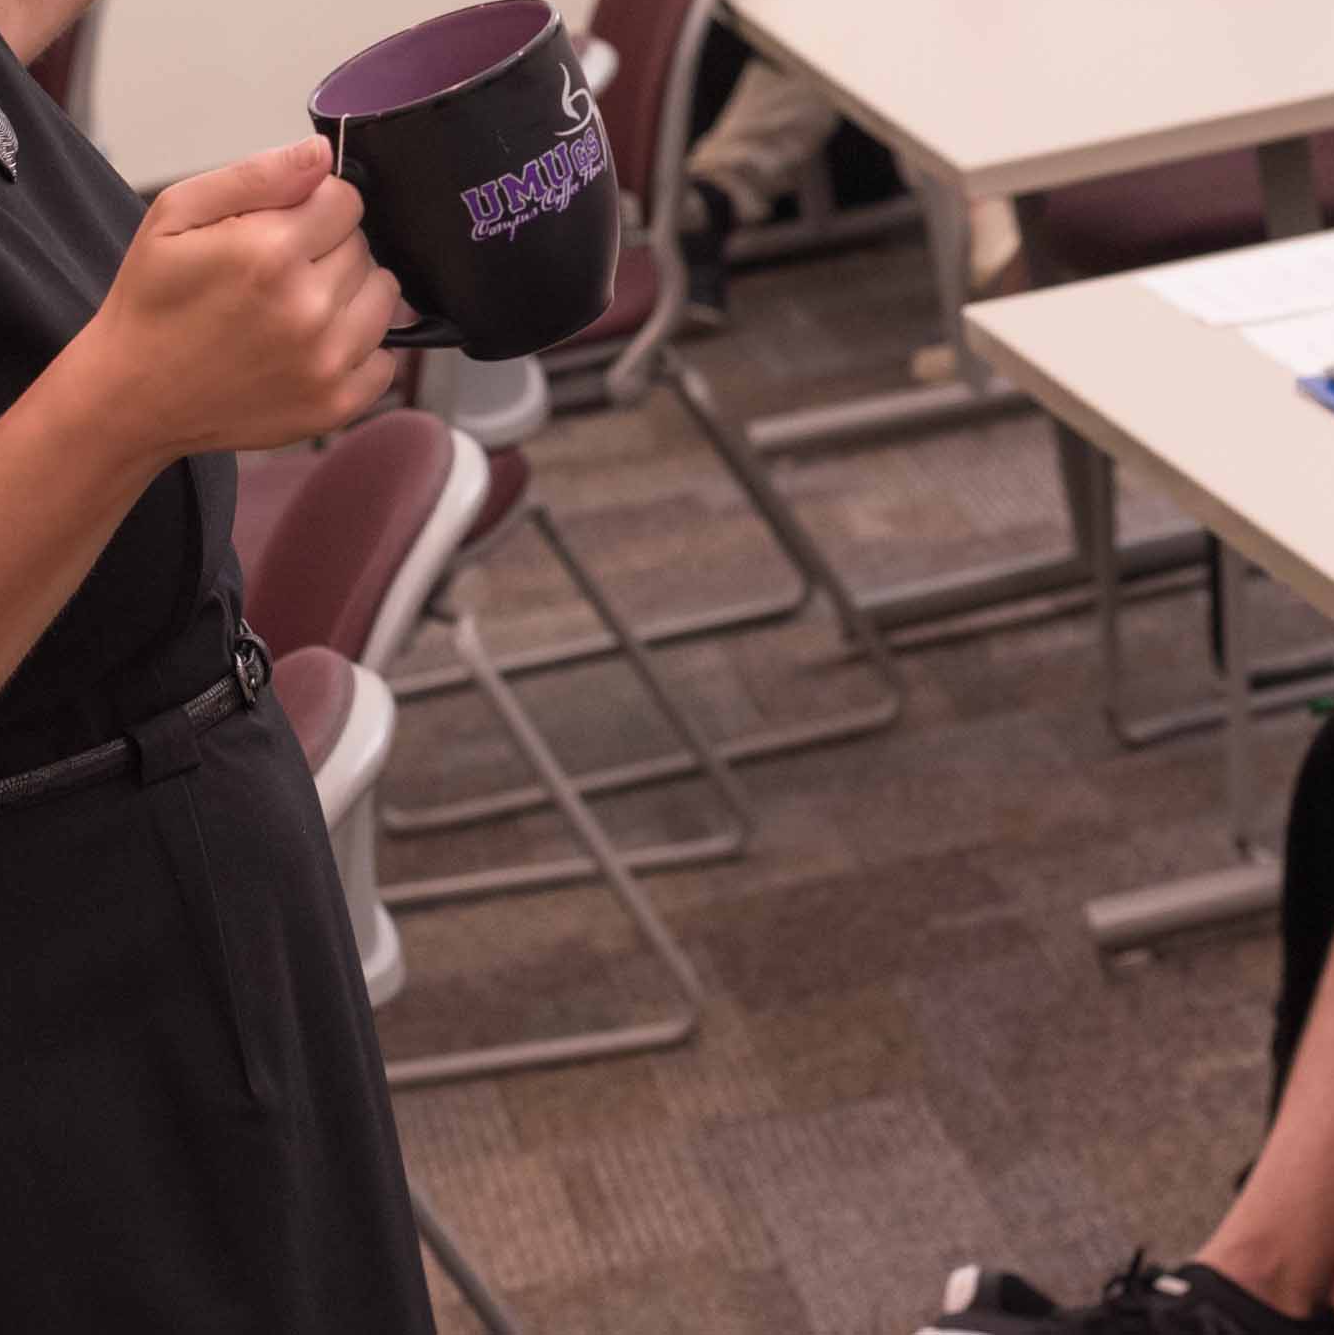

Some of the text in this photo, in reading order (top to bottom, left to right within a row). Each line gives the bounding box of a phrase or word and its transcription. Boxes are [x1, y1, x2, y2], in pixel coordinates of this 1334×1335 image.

[460, 126, 601, 223] UMUGS
[471, 207, 538, 241] Campus
[541, 177, 580, 213] Coffee
